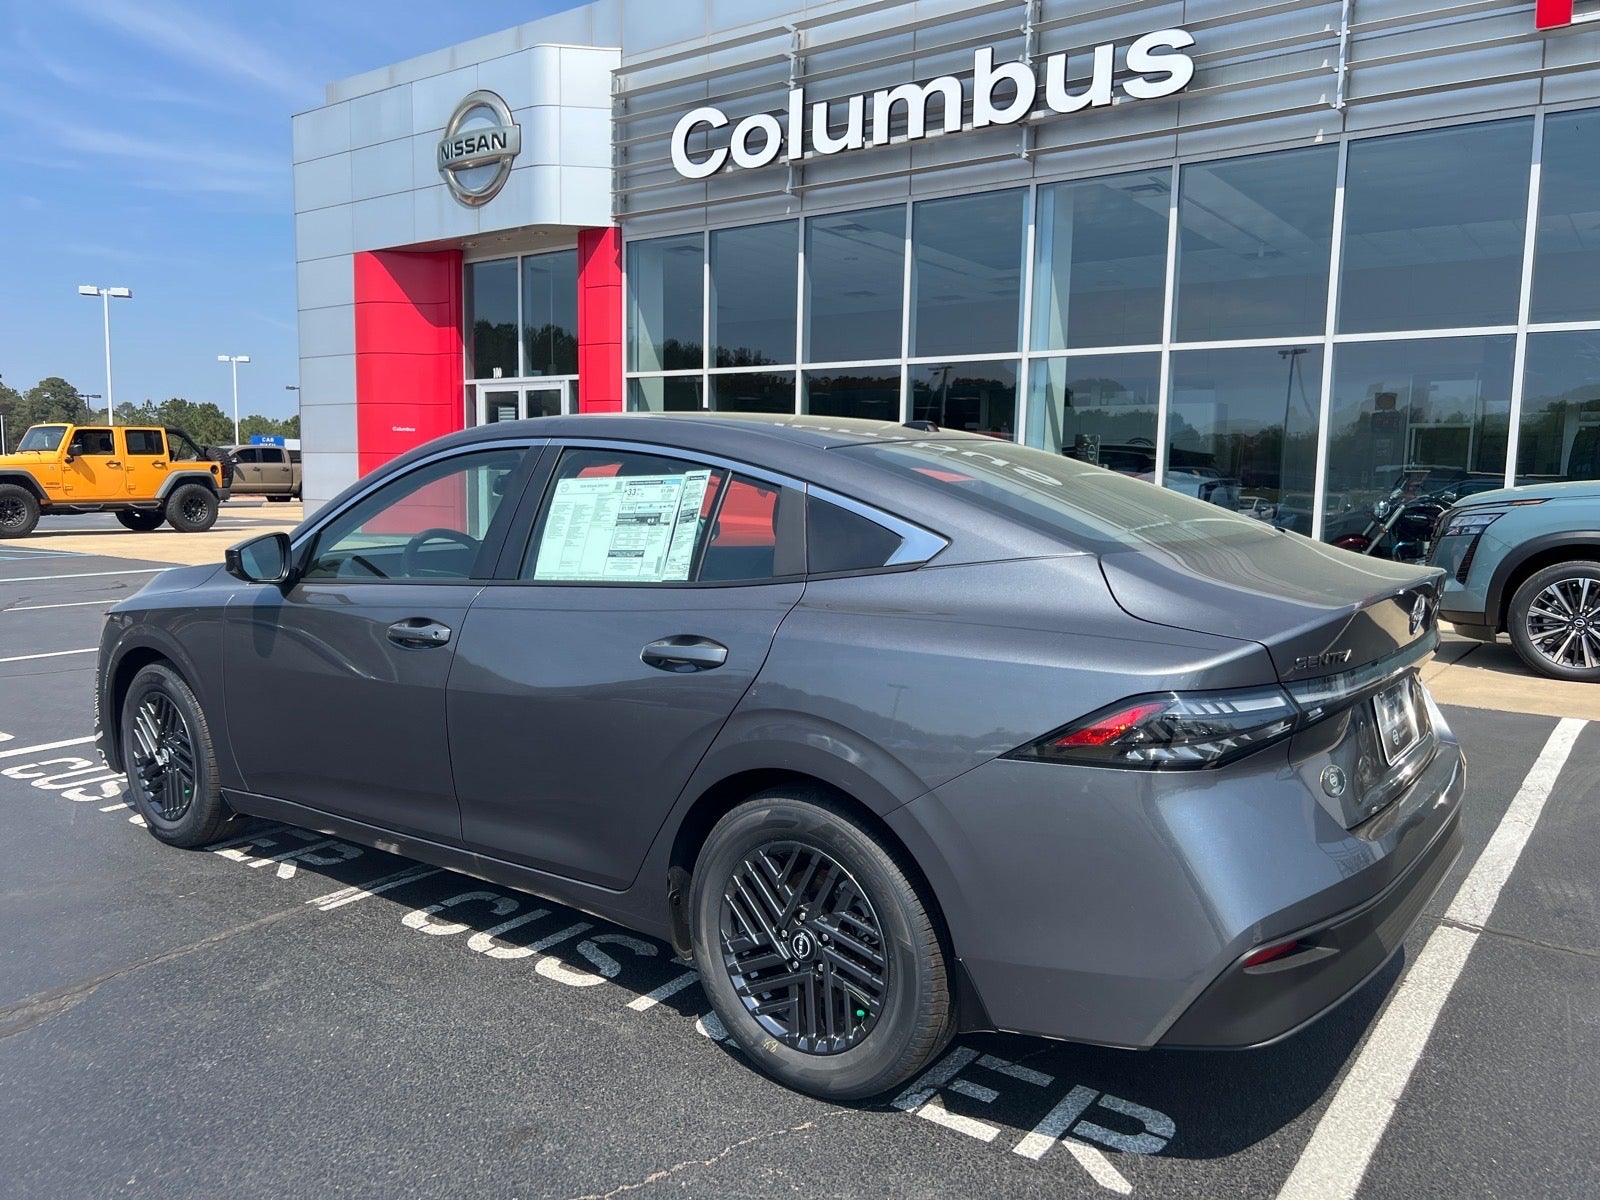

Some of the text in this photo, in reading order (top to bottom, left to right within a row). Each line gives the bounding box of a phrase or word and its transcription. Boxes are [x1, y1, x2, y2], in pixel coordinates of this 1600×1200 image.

[670, 29, 1195, 178] Columbus
[440, 132, 507, 161] NISSAN
[1295, 648, 1352, 669] SENTRA
